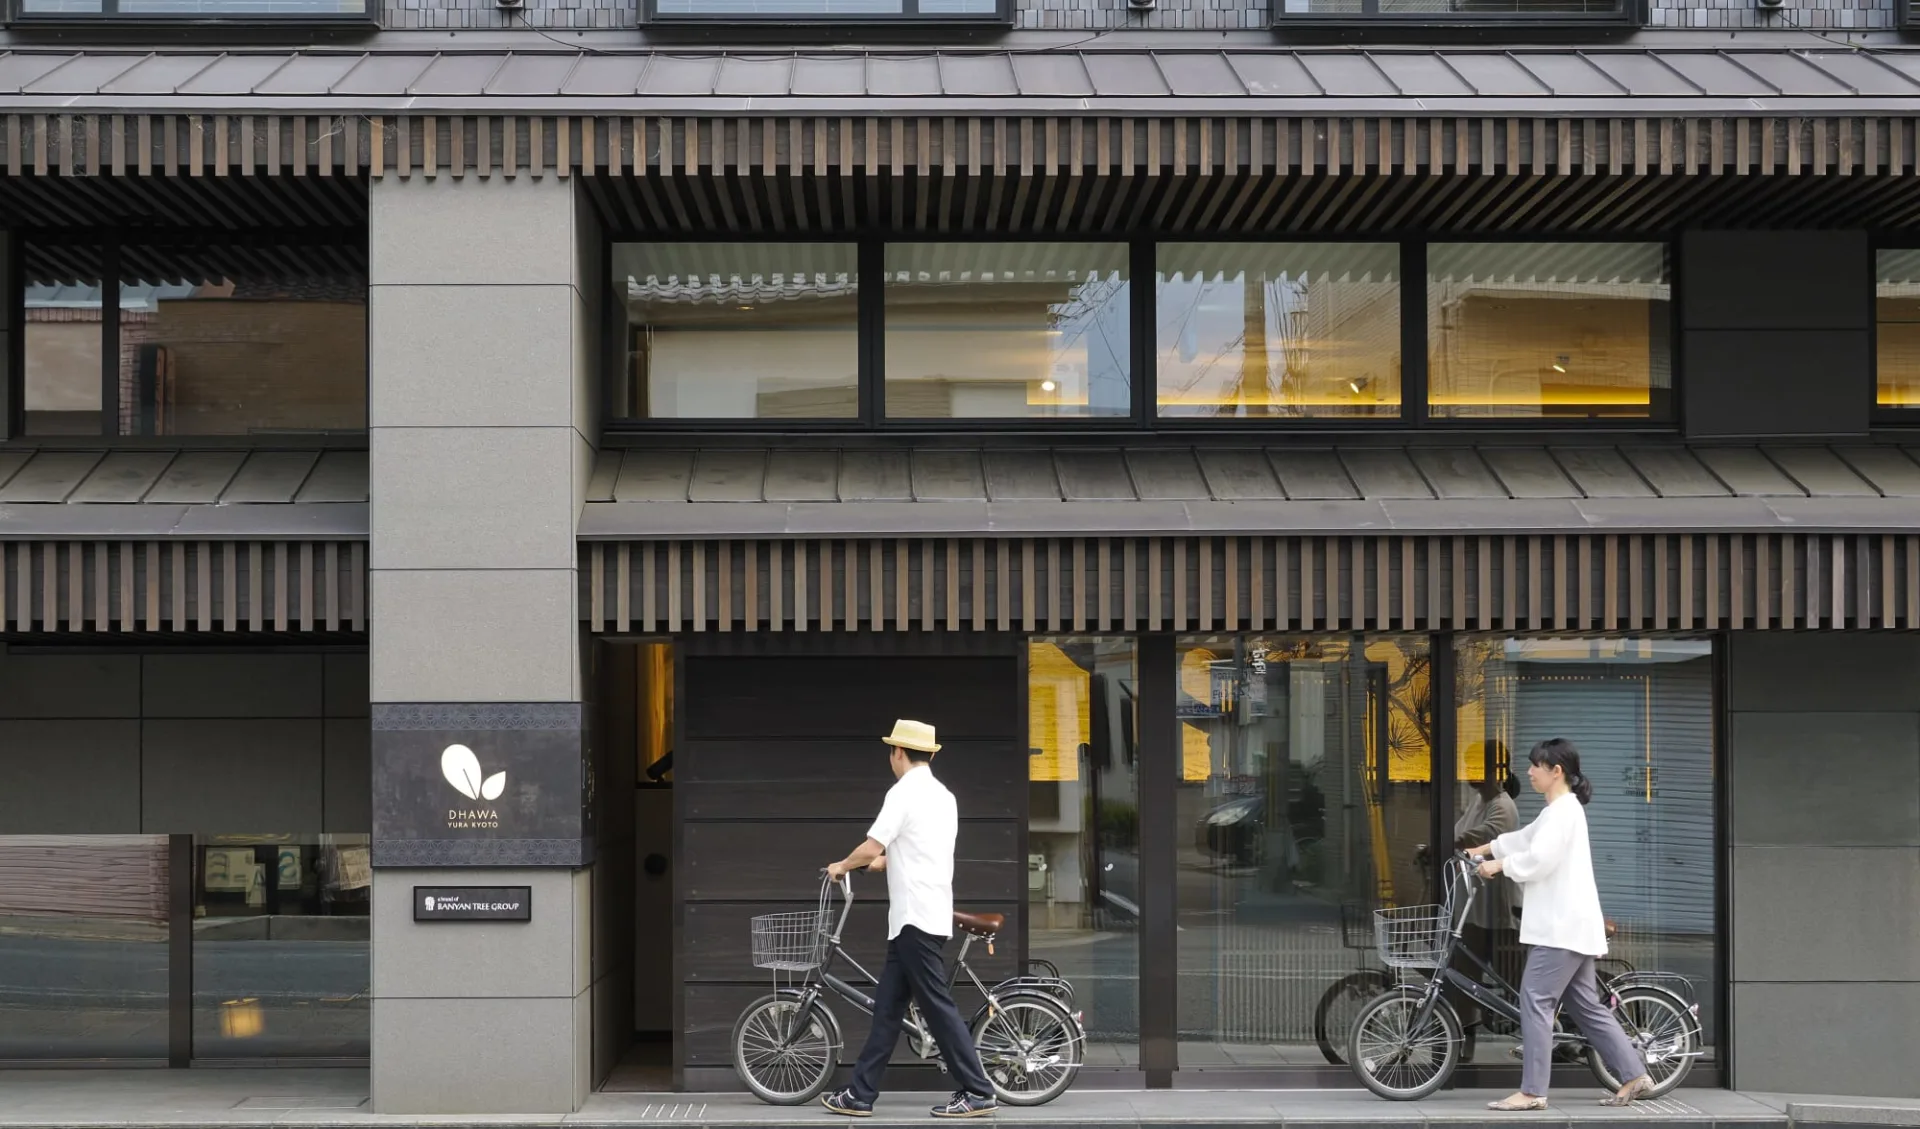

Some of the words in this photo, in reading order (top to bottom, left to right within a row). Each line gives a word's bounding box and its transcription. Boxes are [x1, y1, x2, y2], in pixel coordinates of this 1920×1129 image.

[448, 809, 498, 820] DHAWA
[447, 821, 469, 829] YURA
[471, 821, 499, 829] KYOTO
[437, 902, 471, 911] BANYAN
[472, 902, 490, 911] TREE
[490, 902, 520, 911] GROUP
